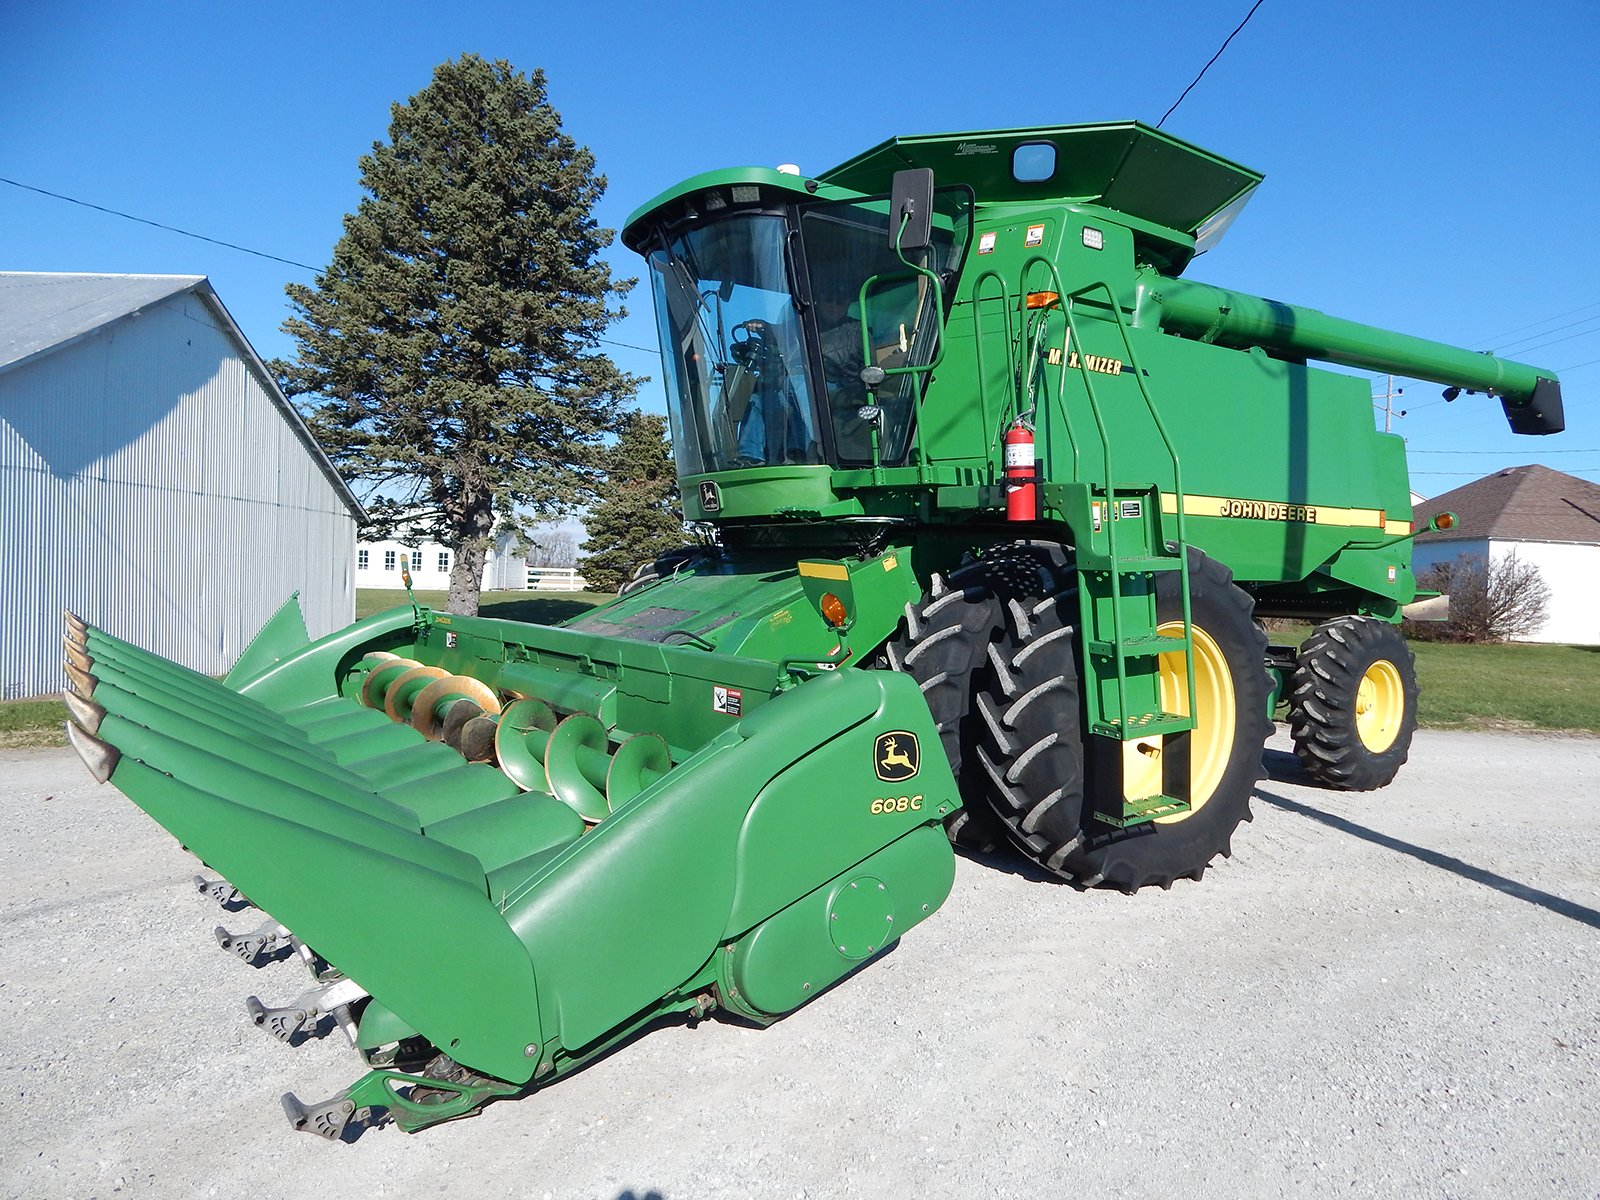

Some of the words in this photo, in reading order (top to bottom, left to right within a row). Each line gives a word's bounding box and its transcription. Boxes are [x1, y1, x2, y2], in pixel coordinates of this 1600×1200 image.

[1047, 348, 1121, 375] MXMIZER
[1220, 500, 1267, 519] JOHN
[1268, 504, 1316, 523] DEERE
[870, 794, 923, 815] 608C
